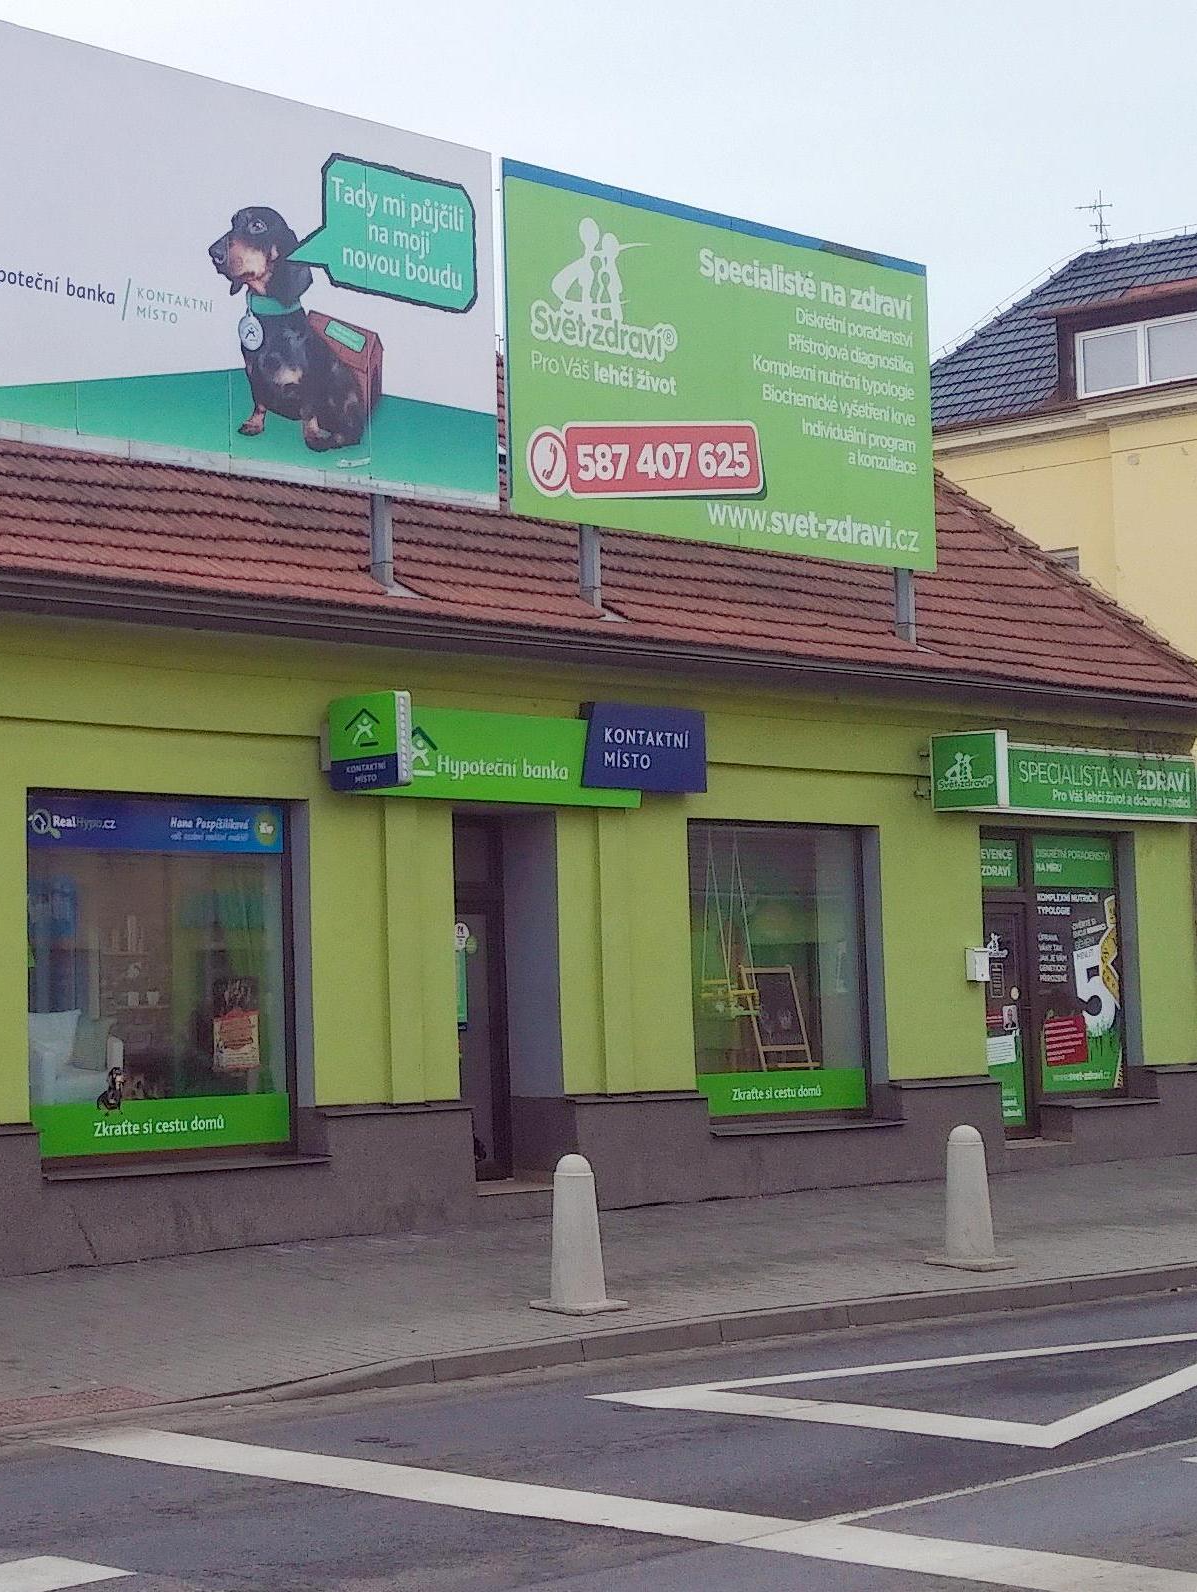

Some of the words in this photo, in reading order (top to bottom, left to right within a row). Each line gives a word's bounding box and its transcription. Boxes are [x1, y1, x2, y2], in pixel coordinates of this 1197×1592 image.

[331, 176, 377, 217] Tady
[383, 195, 405, 218] mi
[410, 200, 464, 233] půjčili
[368, 222, 390, 245] na
[393, 229, 430, 260] moji
[342, 246, 400, 277] novou
[405, 259, 462, 291] boudu
[66, 278, 115, 305] banka
[699, 248, 815, 299] Specialisté
[821, 280, 846, 307] na
[850, 285, 911, 321] zdraví
[136, 287, 213, 313] KONTAKTNÍ
[136, 305, 178, 324] MÍSTO
[796, 307, 846, 333] Diskrétní
[848, 321, 913, 348] poradenství
[531, 351, 559, 374] Pro
[561, 355, 590, 380] Váš
[594, 360, 633, 388] lehčí
[636, 367, 677, 395] život
[851, 346, 914, 374] diagnostika
[753, 354, 816, 382] Komplexní
[862, 374, 914, 401] typologie
[762, 383, 838, 412] Biochemické
[891, 407, 916, 427] krve
[868, 432, 916, 454] program
[577, 443, 629, 481] 587
[636, 443, 691, 479] 407
[697, 442, 751, 478] 625
[848, 453, 856, 465] a
[857, 449, 917, 475] konzultace
[707, 502, 919, 552] www.svet-zdravi.cz
[604, 727, 689, 750] KONTAKTNÍ
[437, 754, 517, 779] Hypoteční
[522, 759, 569, 780] banka
[604, 749, 651, 770] MÍSTO
[1018, 760, 1111, 788] SPECIALISTA
[1113, 767, 1134, 789] NA
[1137, 768, 1190, 793] ZDRAVÍ
[980, 848, 1013, 860] EVENCE
[766, 1087, 773, 1099] si
[774, 1087, 796, 1099] cestu
[142, 1119, 153, 1135] si
[155, 1117, 188, 1134] cestu
[191, 1114, 225, 1131] domů
